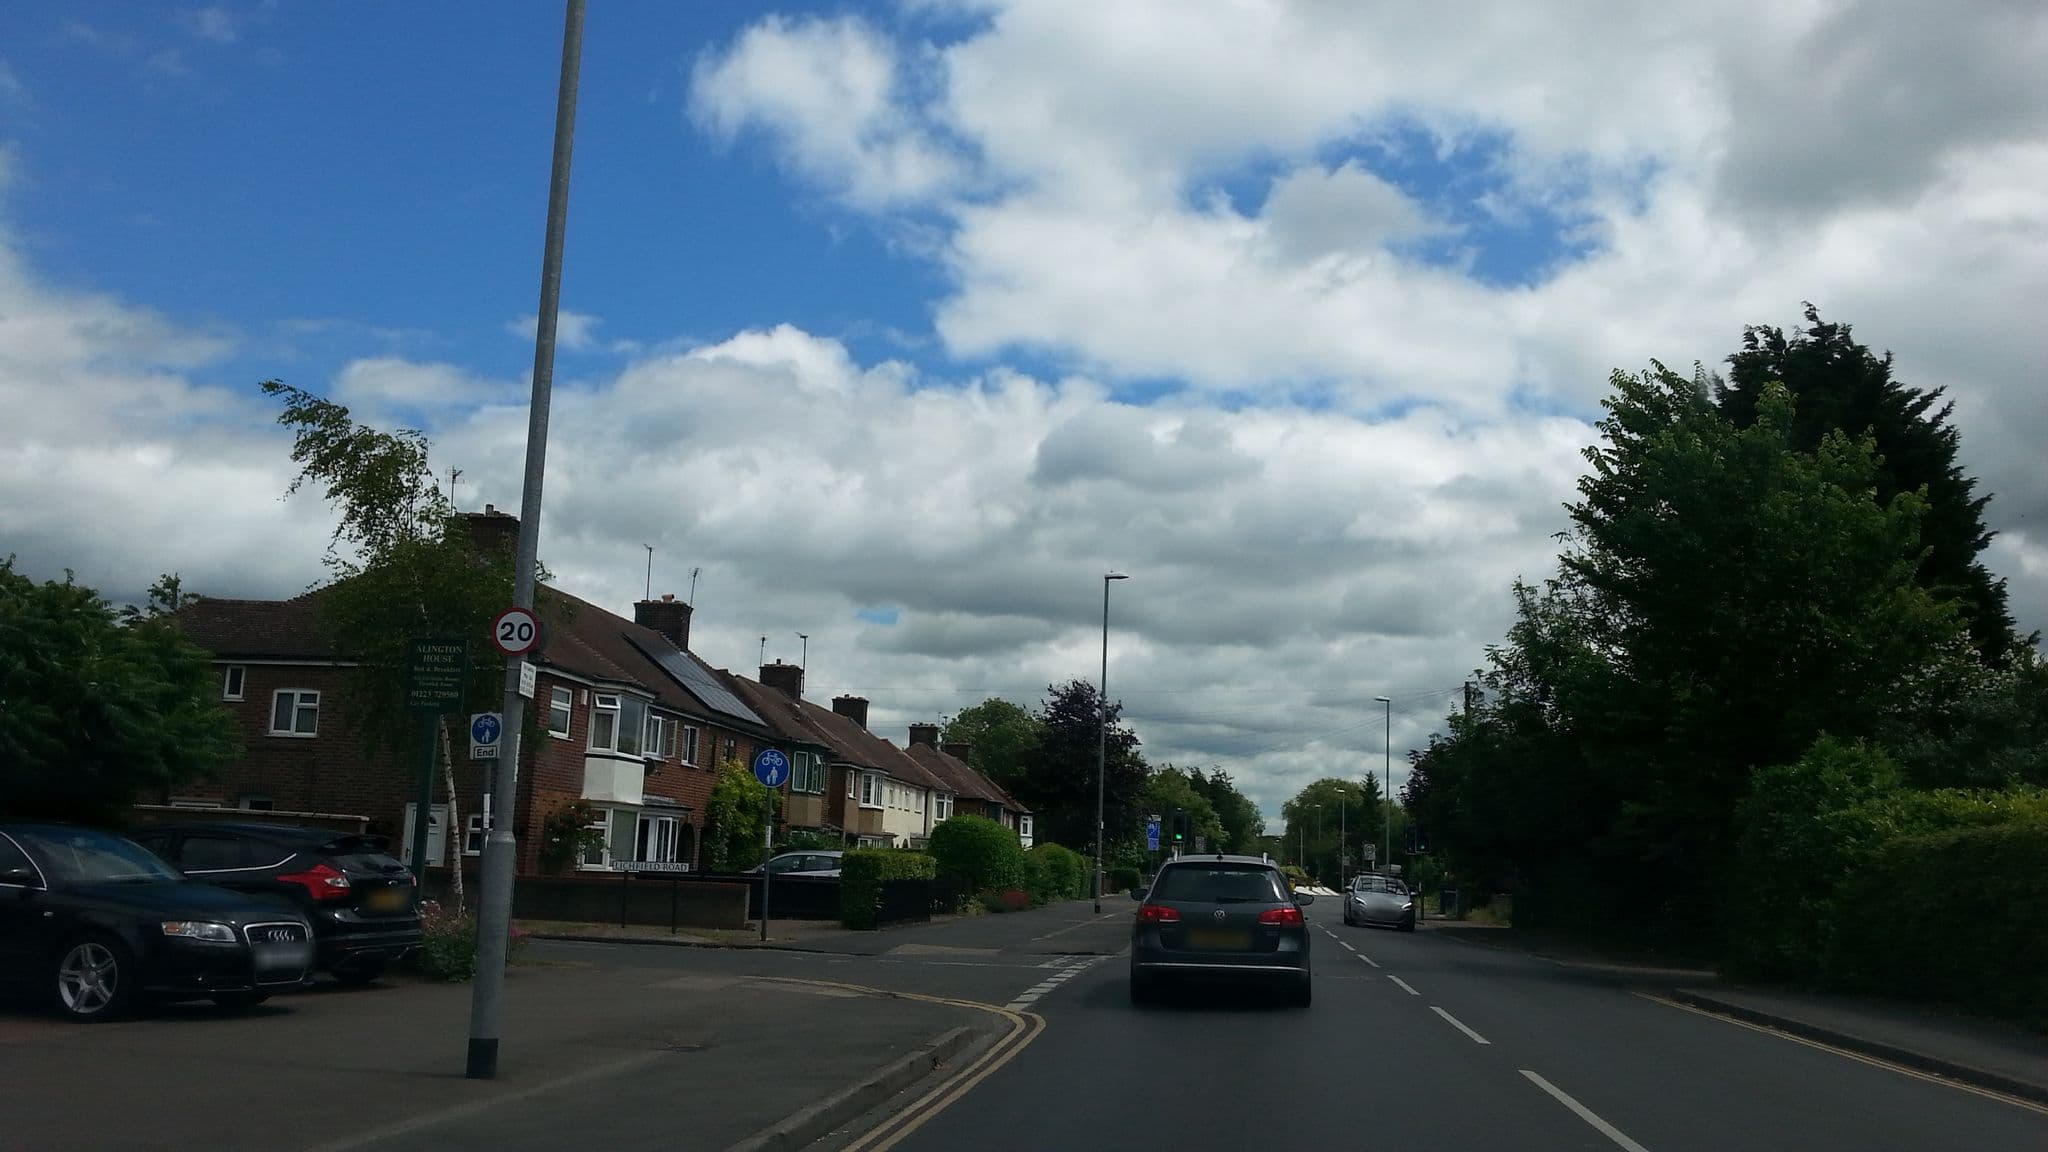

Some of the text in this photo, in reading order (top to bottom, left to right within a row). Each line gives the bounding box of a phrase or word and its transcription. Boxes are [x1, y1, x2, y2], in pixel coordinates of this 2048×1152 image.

[500, 622, 533, 641] 20
[417, 644, 463, 653] ALINGTON
[423, 654, 455, 663] HOUSE
[411, 690, 432, 698] 01223
[476, 747, 494, 757] End
[614, 861, 687, 872] LICHFIELD ROAD
